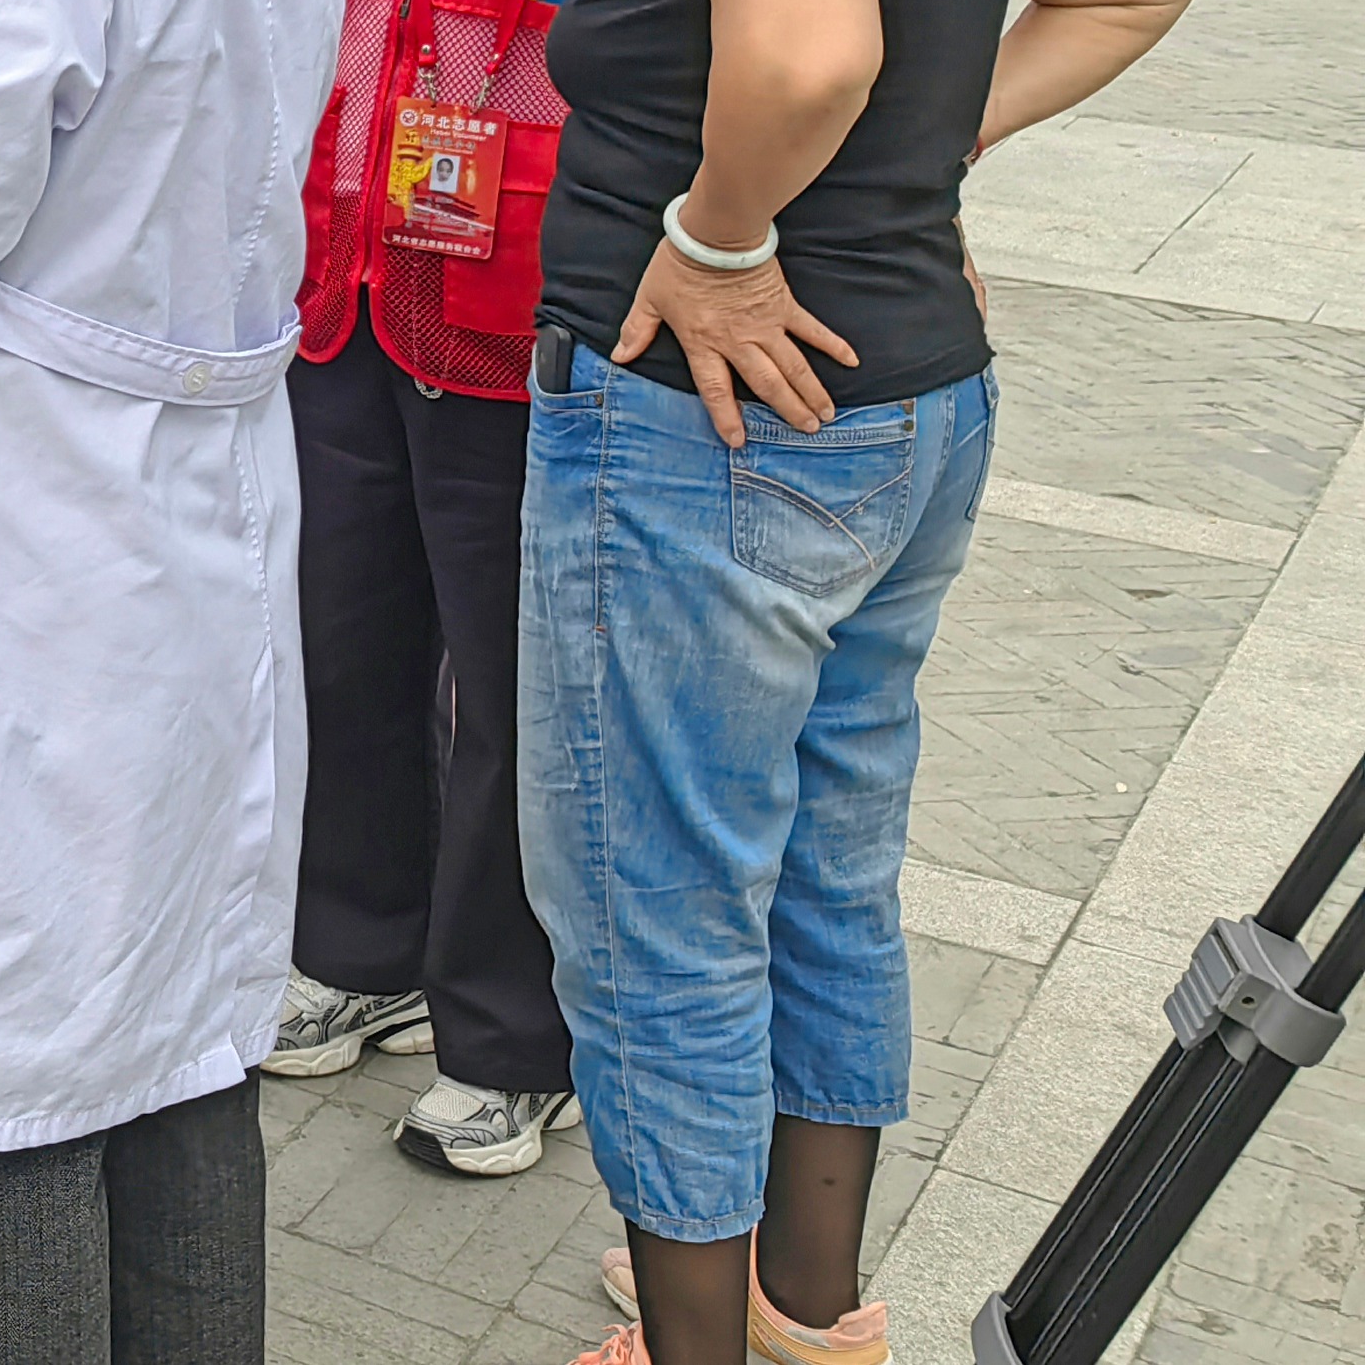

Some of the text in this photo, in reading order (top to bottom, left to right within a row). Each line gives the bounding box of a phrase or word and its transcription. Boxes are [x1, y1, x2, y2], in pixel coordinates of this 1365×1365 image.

[421, 113, 498, 136] 河北志愿者
[392, 234, 481, 255] 河北省志愿服务联合会
